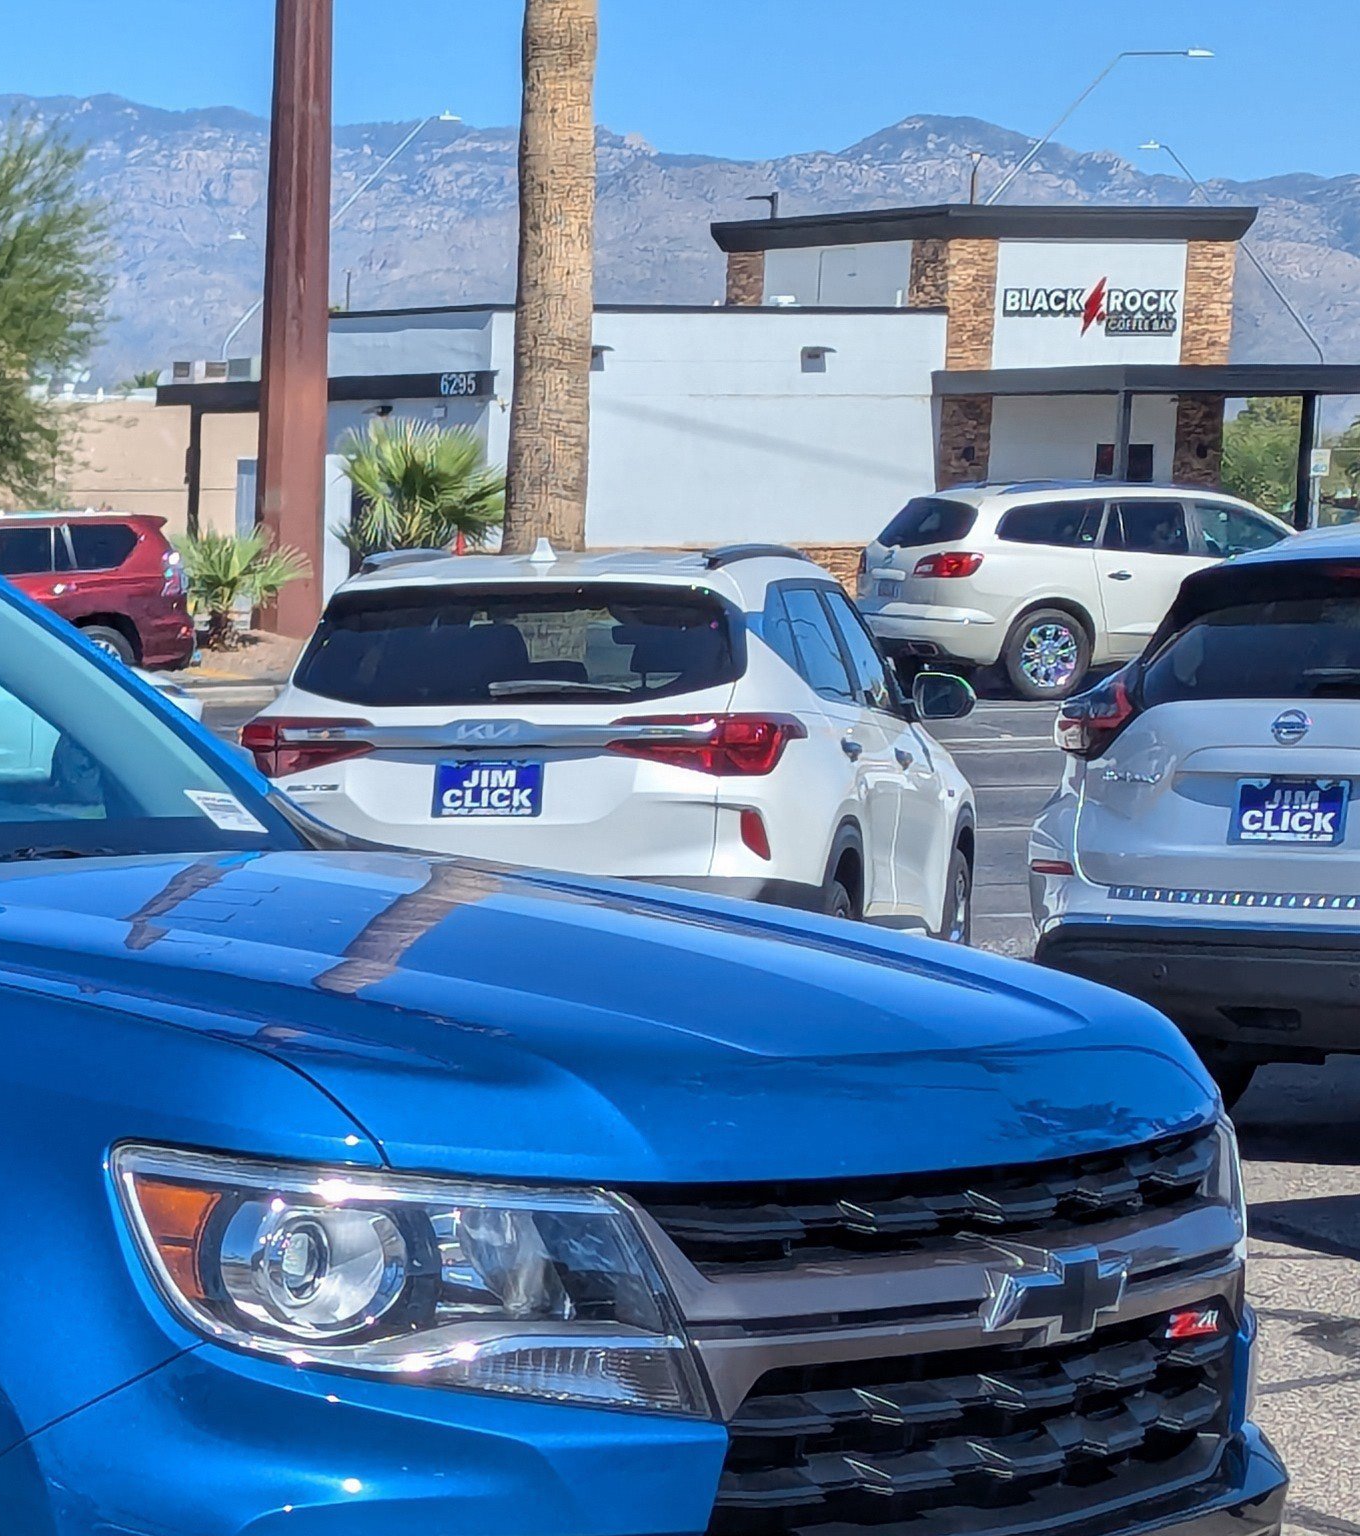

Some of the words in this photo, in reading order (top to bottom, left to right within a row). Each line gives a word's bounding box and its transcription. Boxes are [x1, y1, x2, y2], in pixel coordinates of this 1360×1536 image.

[1004, 289, 1085, 315] BLACK
[1107, 290, 1177, 314] ROCK
[1107, 317, 1149, 331] COFFEE
[1151, 318, 1176, 331] BAR
[440, 372, 477, 396] 6295
[462, 769, 517, 788] JIM
[442, 788, 533, 808] CLICK
[1264, 789, 1321, 811] JIM
[1241, 809, 1336, 834] CLICK
